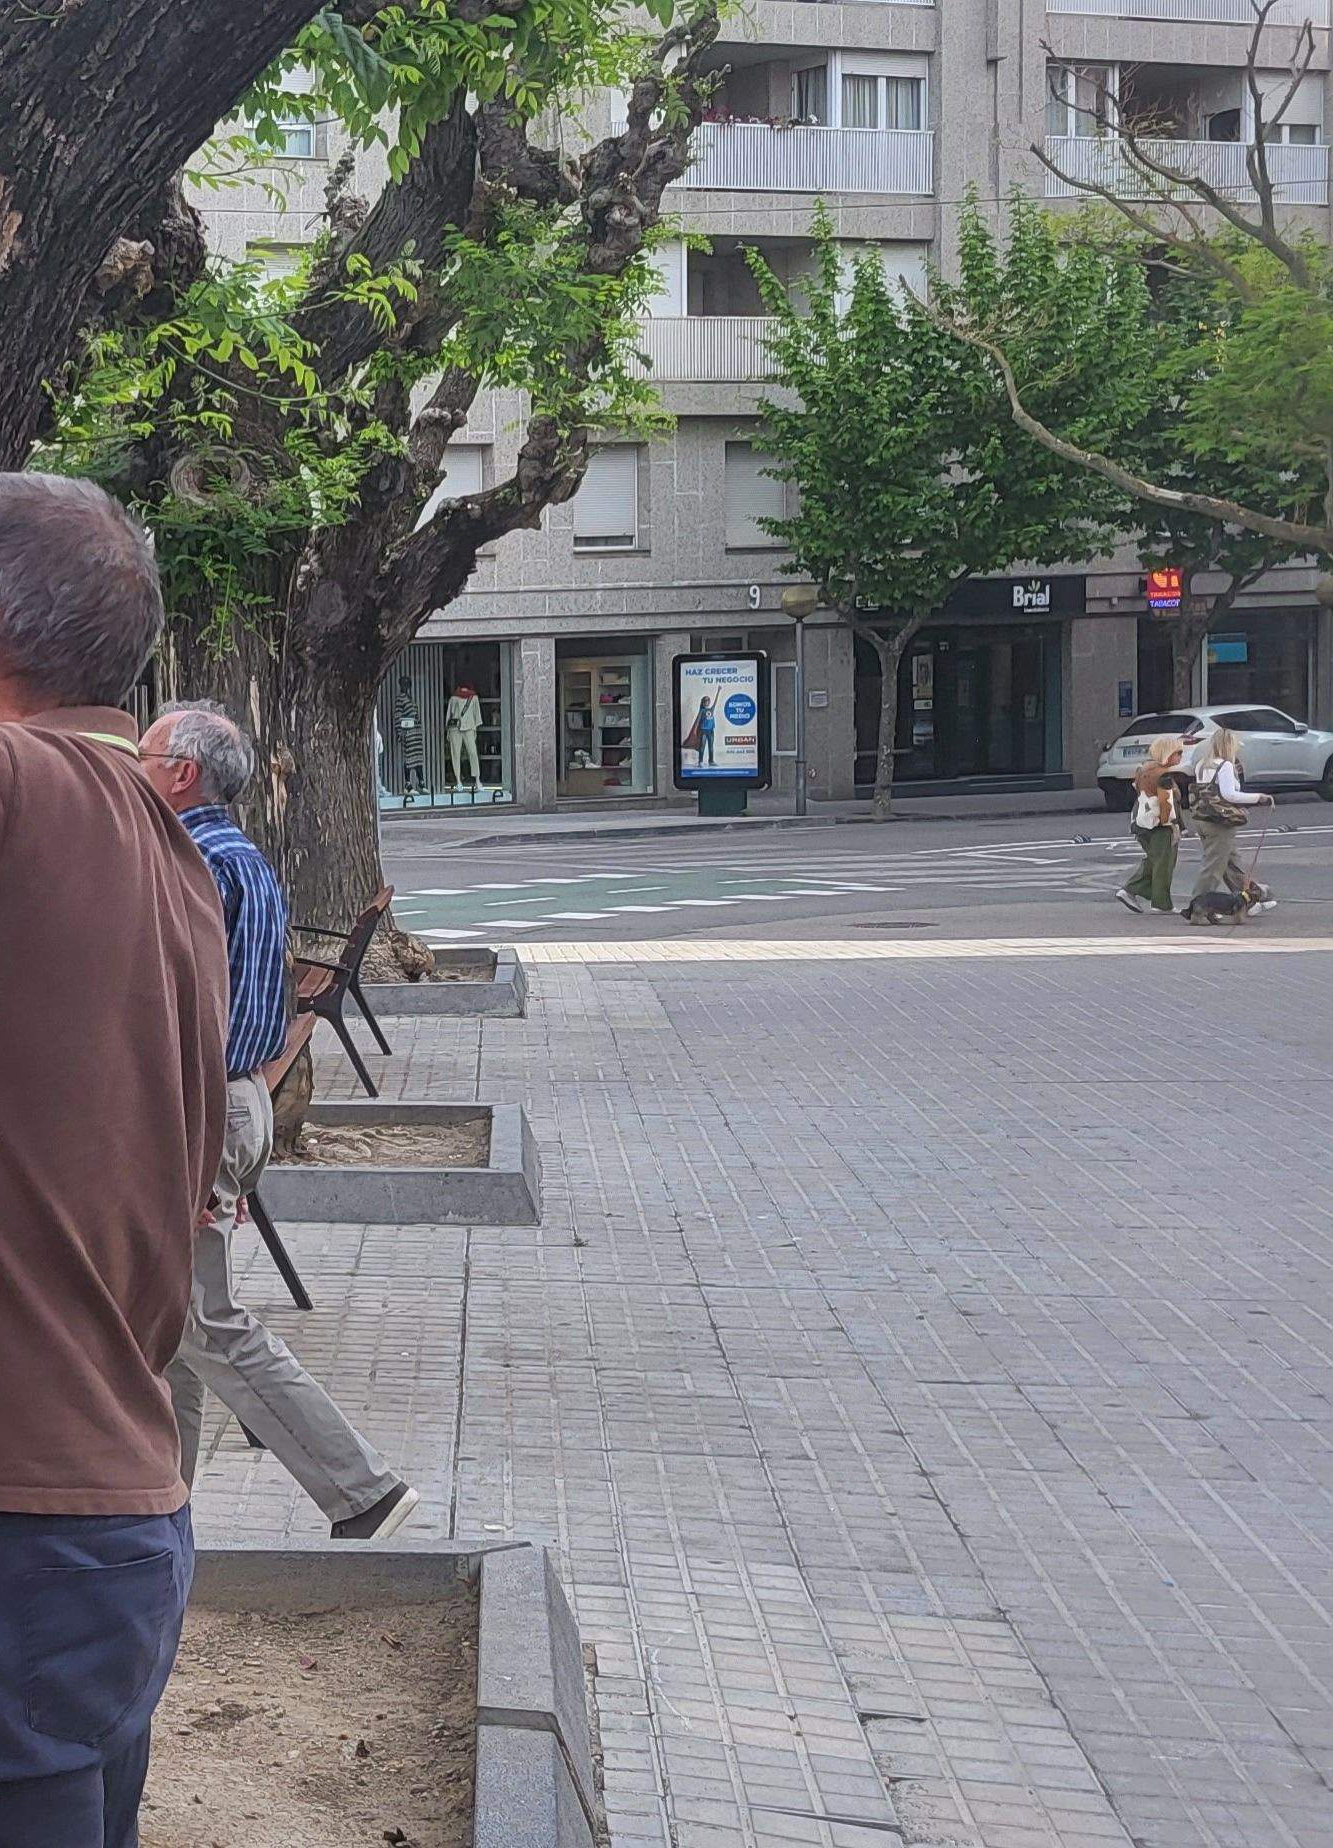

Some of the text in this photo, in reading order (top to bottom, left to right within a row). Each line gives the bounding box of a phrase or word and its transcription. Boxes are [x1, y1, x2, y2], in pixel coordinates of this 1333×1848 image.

[749, 585, 760, 609] 9
[1013, 583, 1051, 607] Brial
[705, 667, 738, 675] CRECER
